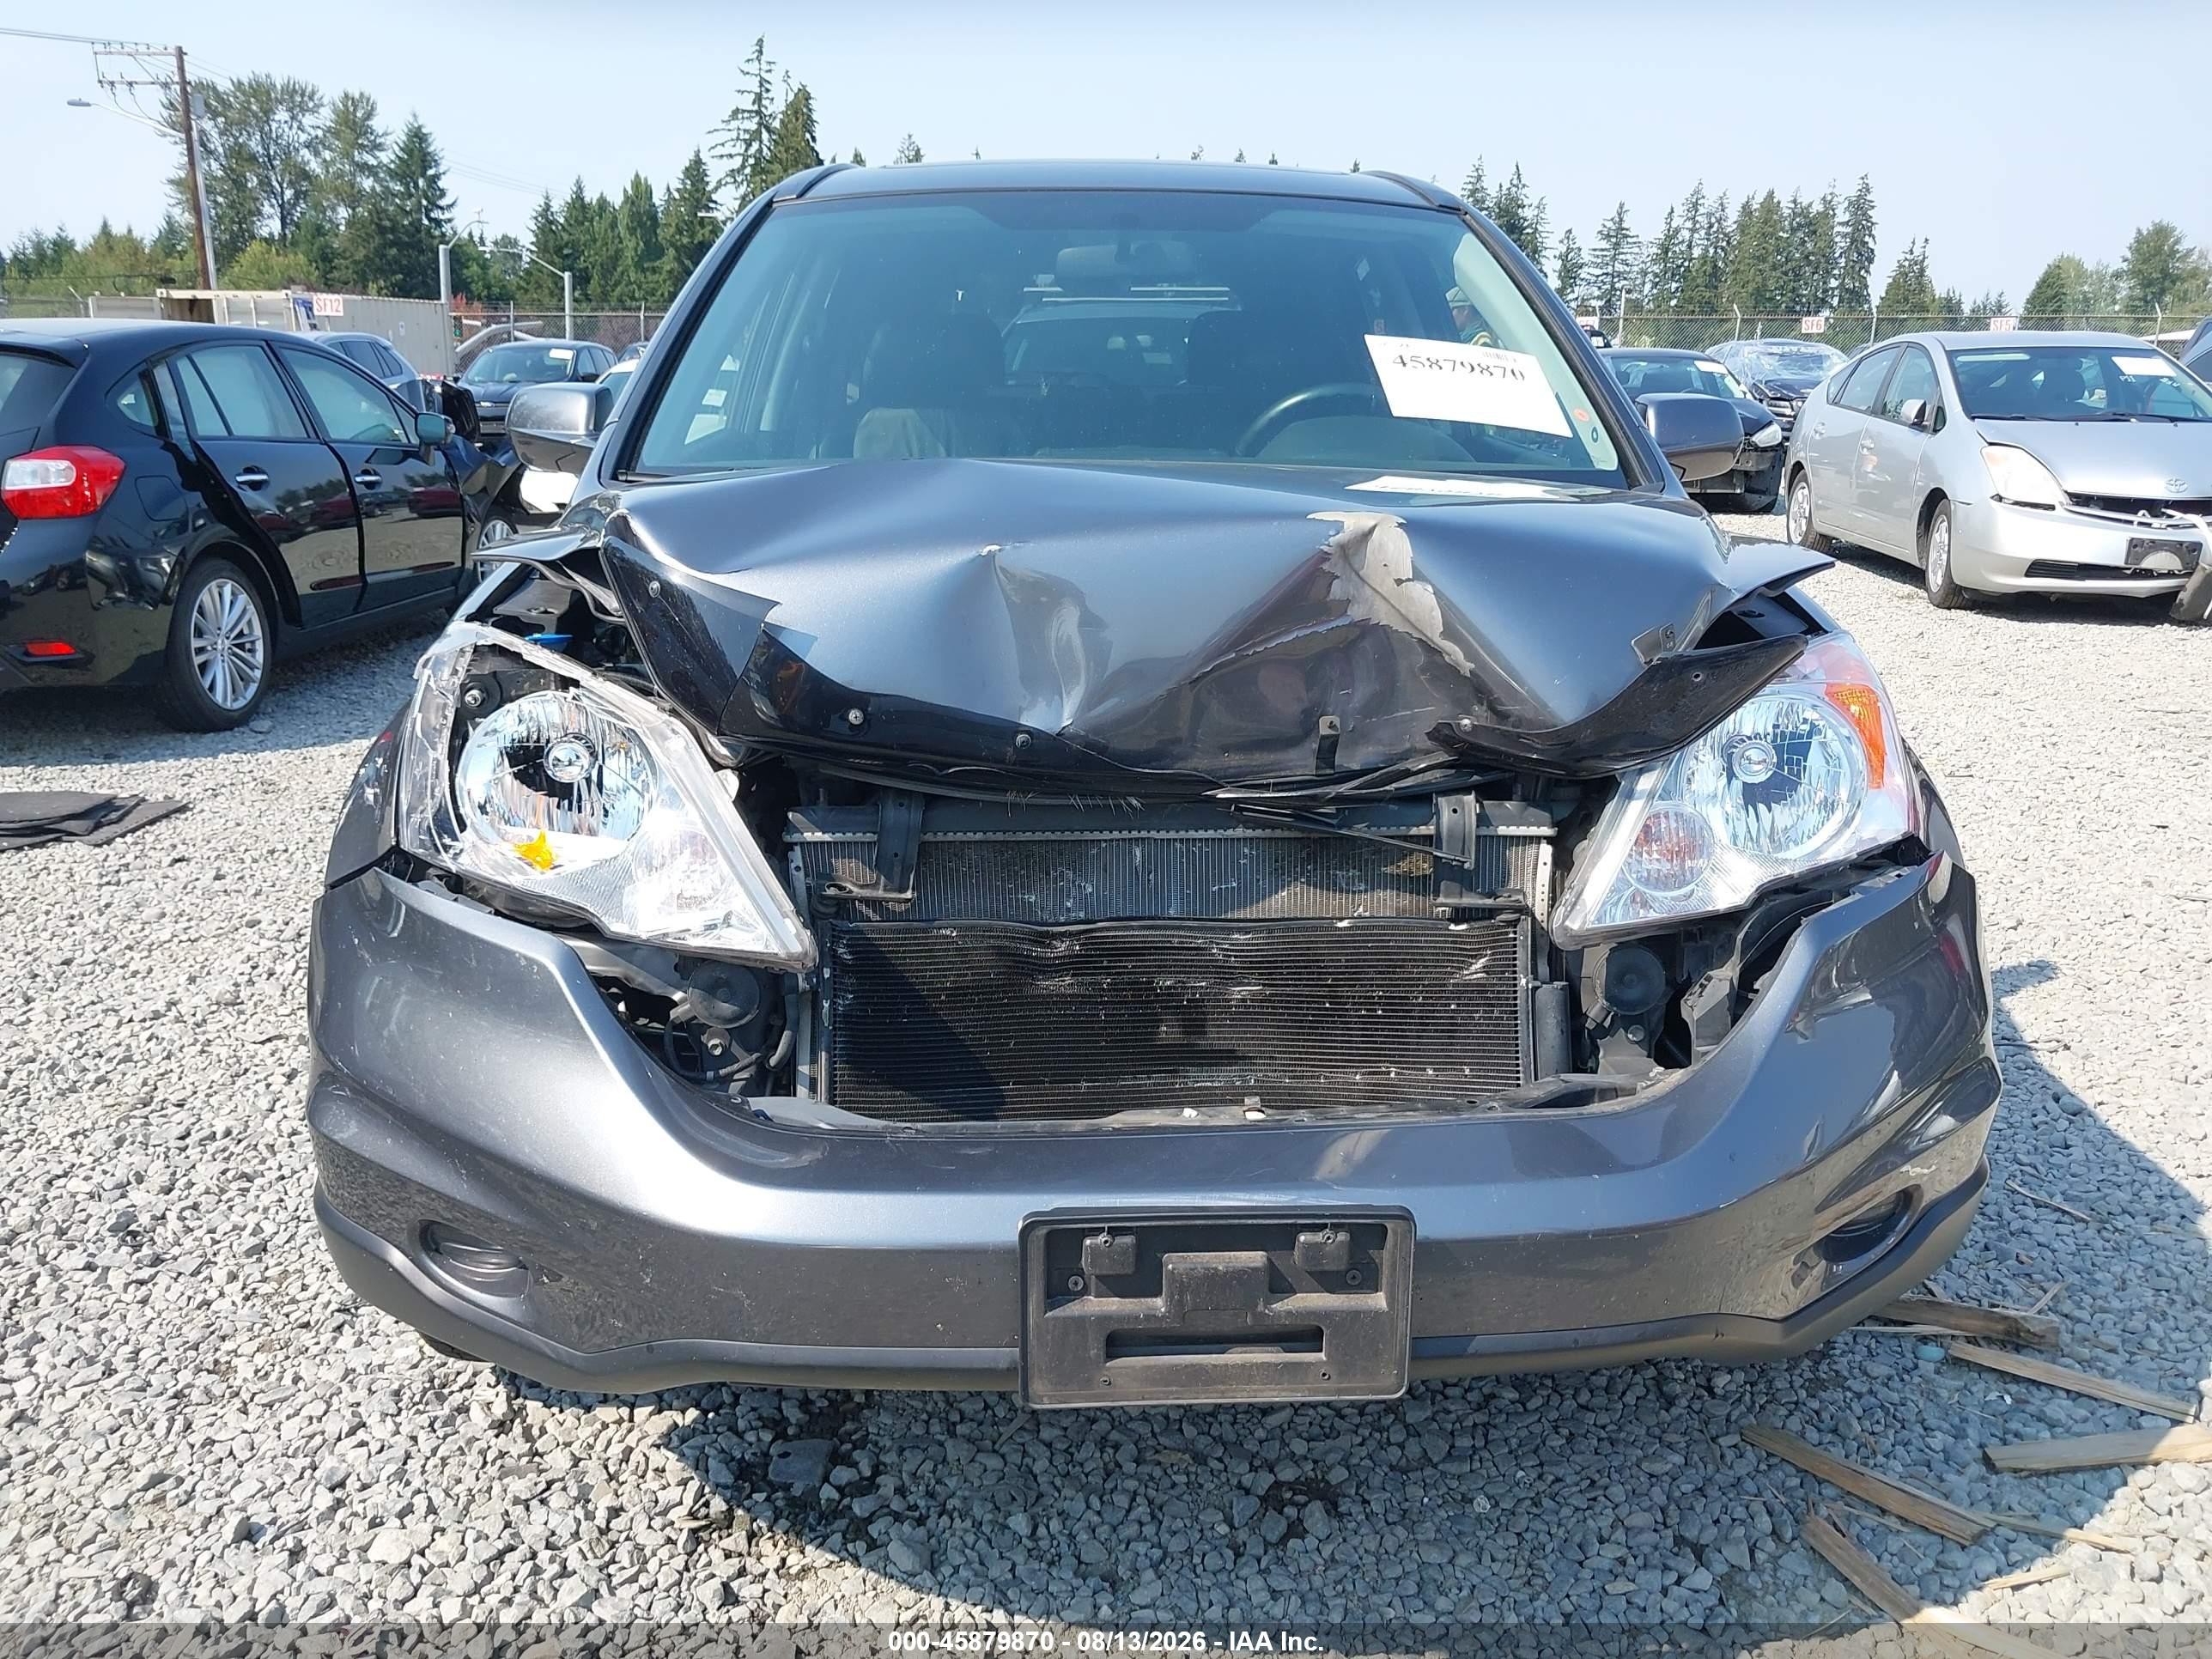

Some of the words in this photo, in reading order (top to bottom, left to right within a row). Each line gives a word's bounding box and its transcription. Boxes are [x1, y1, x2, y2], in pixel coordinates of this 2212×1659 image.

[315, 297, 341, 313] SF12
[1804, 319, 1822, 331] SF6
[1992, 319, 2011, 331] SF5
[1393, 355, 1525, 380] 45879870
